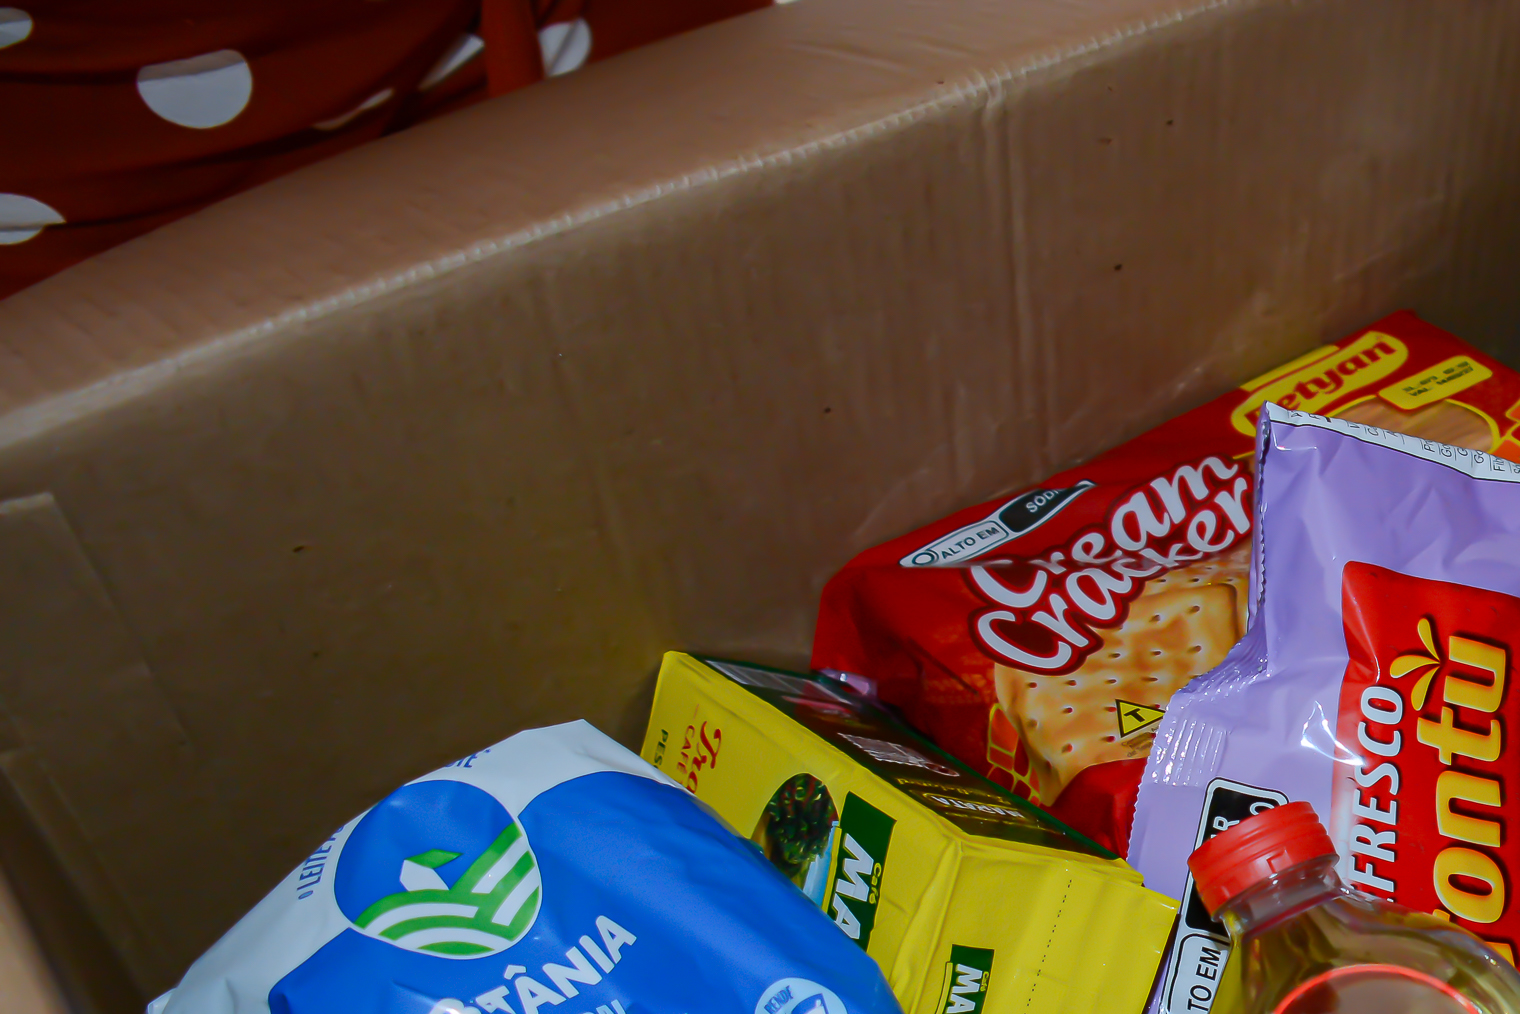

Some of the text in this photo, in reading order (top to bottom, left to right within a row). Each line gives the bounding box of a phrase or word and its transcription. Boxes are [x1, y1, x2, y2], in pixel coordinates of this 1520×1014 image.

[1243, 334, 1398, 425] etyan
[940, 525, 1000, 561] ALTO EM
[970, 456, 1241, 607] Cream
[976, 477, 1252, 670] Cracker
[1350, 685, 1404, 902] FRESCO
[868, 861, 882, 906] Café
[1196, 946, 1221, 983] EM
